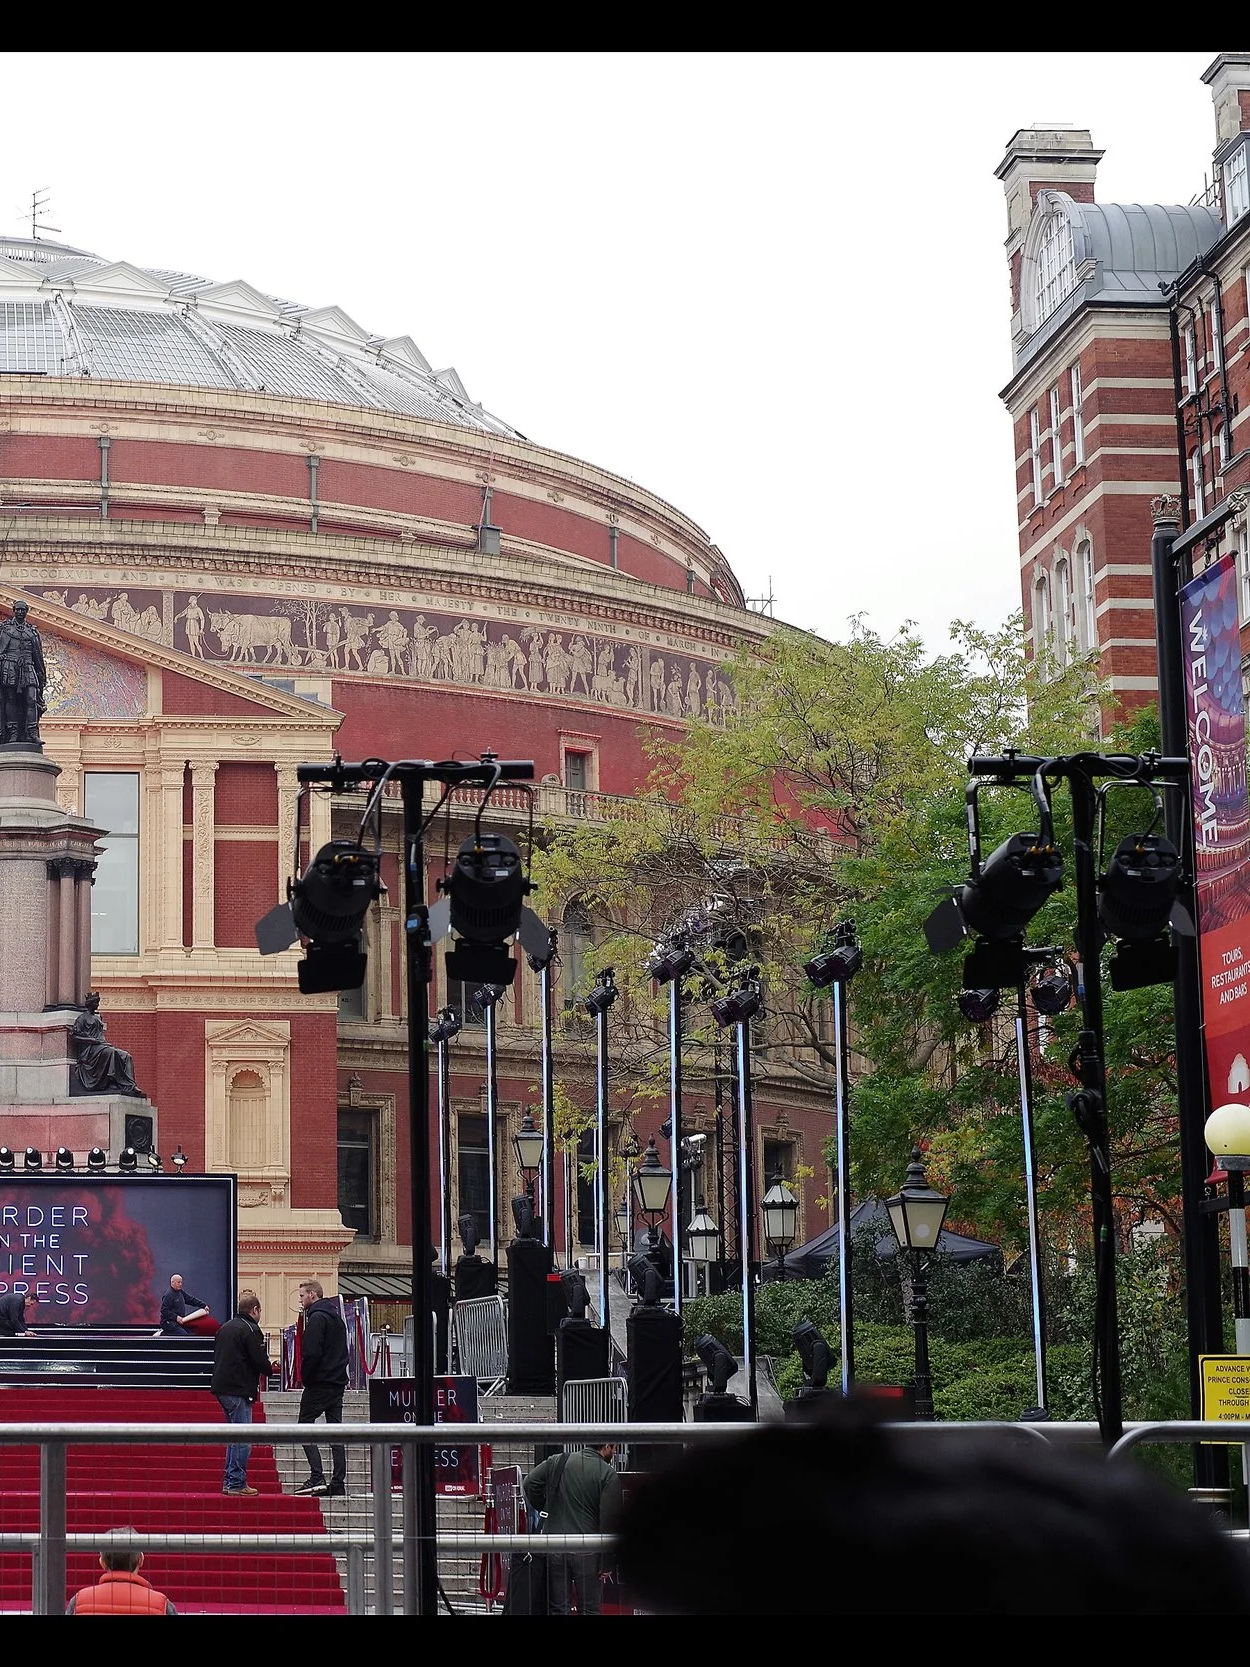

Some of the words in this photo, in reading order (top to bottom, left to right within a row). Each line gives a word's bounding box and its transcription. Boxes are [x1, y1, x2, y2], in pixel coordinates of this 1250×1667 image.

[120, 572, 148, 582] AND
[175, 574, 187, 584] IT
[214, 577, 243, 588] WAS
[268, 581, 317, 594] OPENED
[341, 588, 357, 598] BY
[379, 591, 402, 602] HER
[425, 598, 474, 611] MAJESTY
[497, 606, 517, 617] THE
[538, 612, 580, 627] TWENTY
[587, 620, 616, 634] NINTH
[638, 630, 650, 641] OF
[666, 636, 696, 652] MARCH
[711, 648, 719, 657] IN
[1189, 609, 1218, 848] WELCOME
[1211, 960, 1250, 989] RESTAURANTS
[1220, 988, 1235, 1005] AND
[1234, 982, 1247, 999] BARS
[20, 1234, 60, 1248] THE
